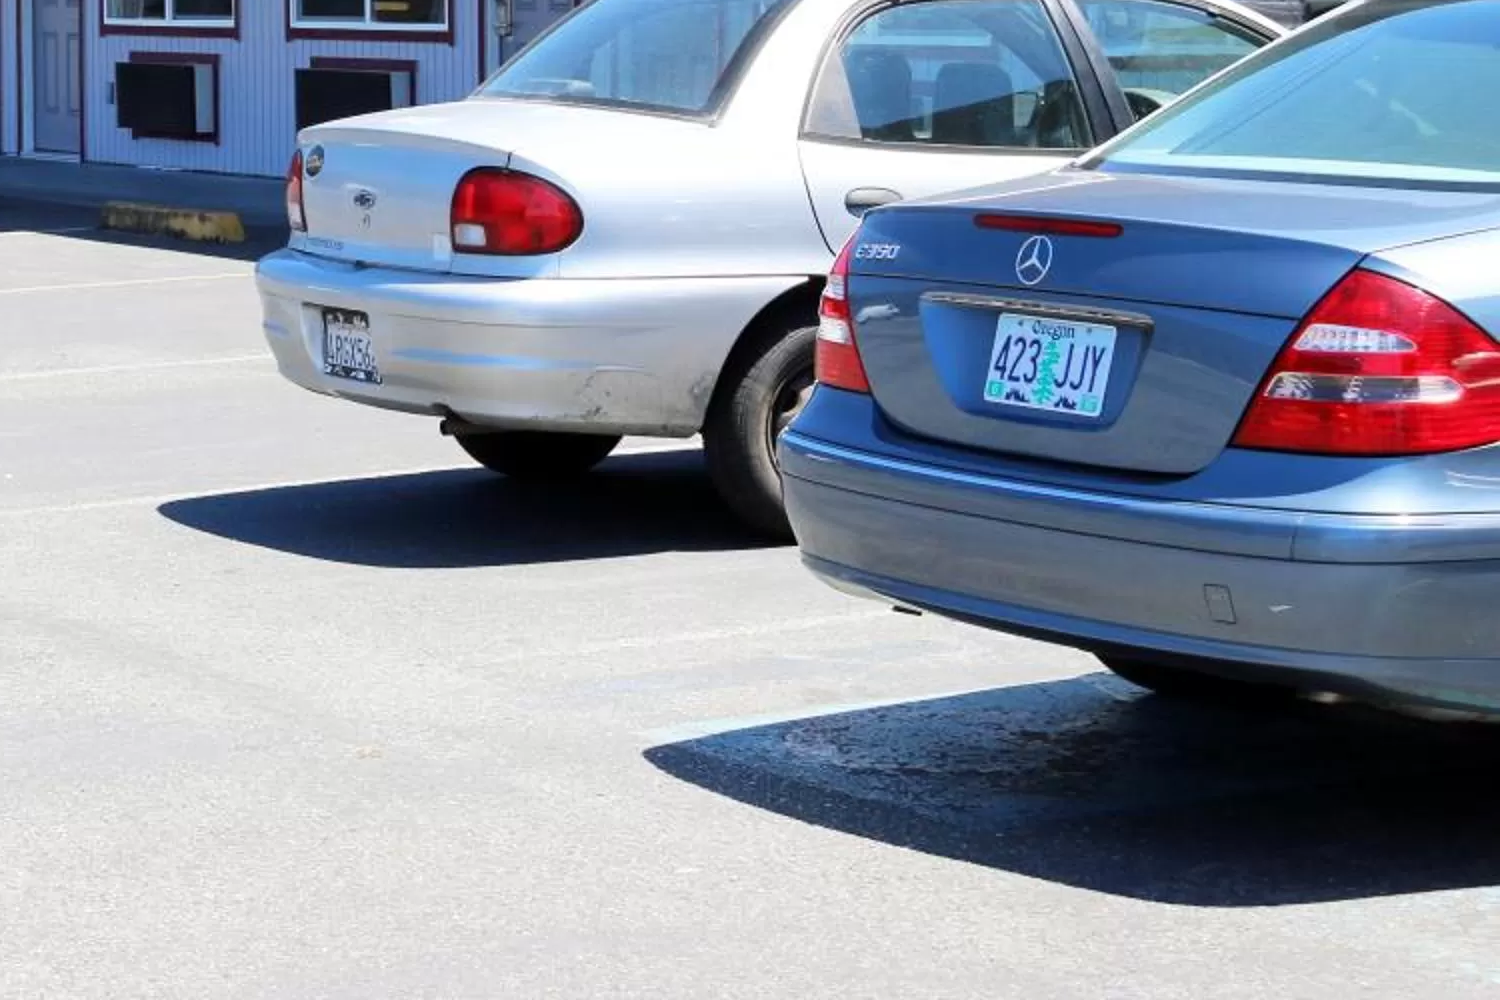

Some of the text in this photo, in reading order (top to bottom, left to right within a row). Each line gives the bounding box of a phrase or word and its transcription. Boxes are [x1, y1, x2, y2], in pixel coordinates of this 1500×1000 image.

[855, 243, 901, 260] E350
[1031, 319, 1076, 341] Oregon
[993, 334, 1106, 393] 423 JJY
